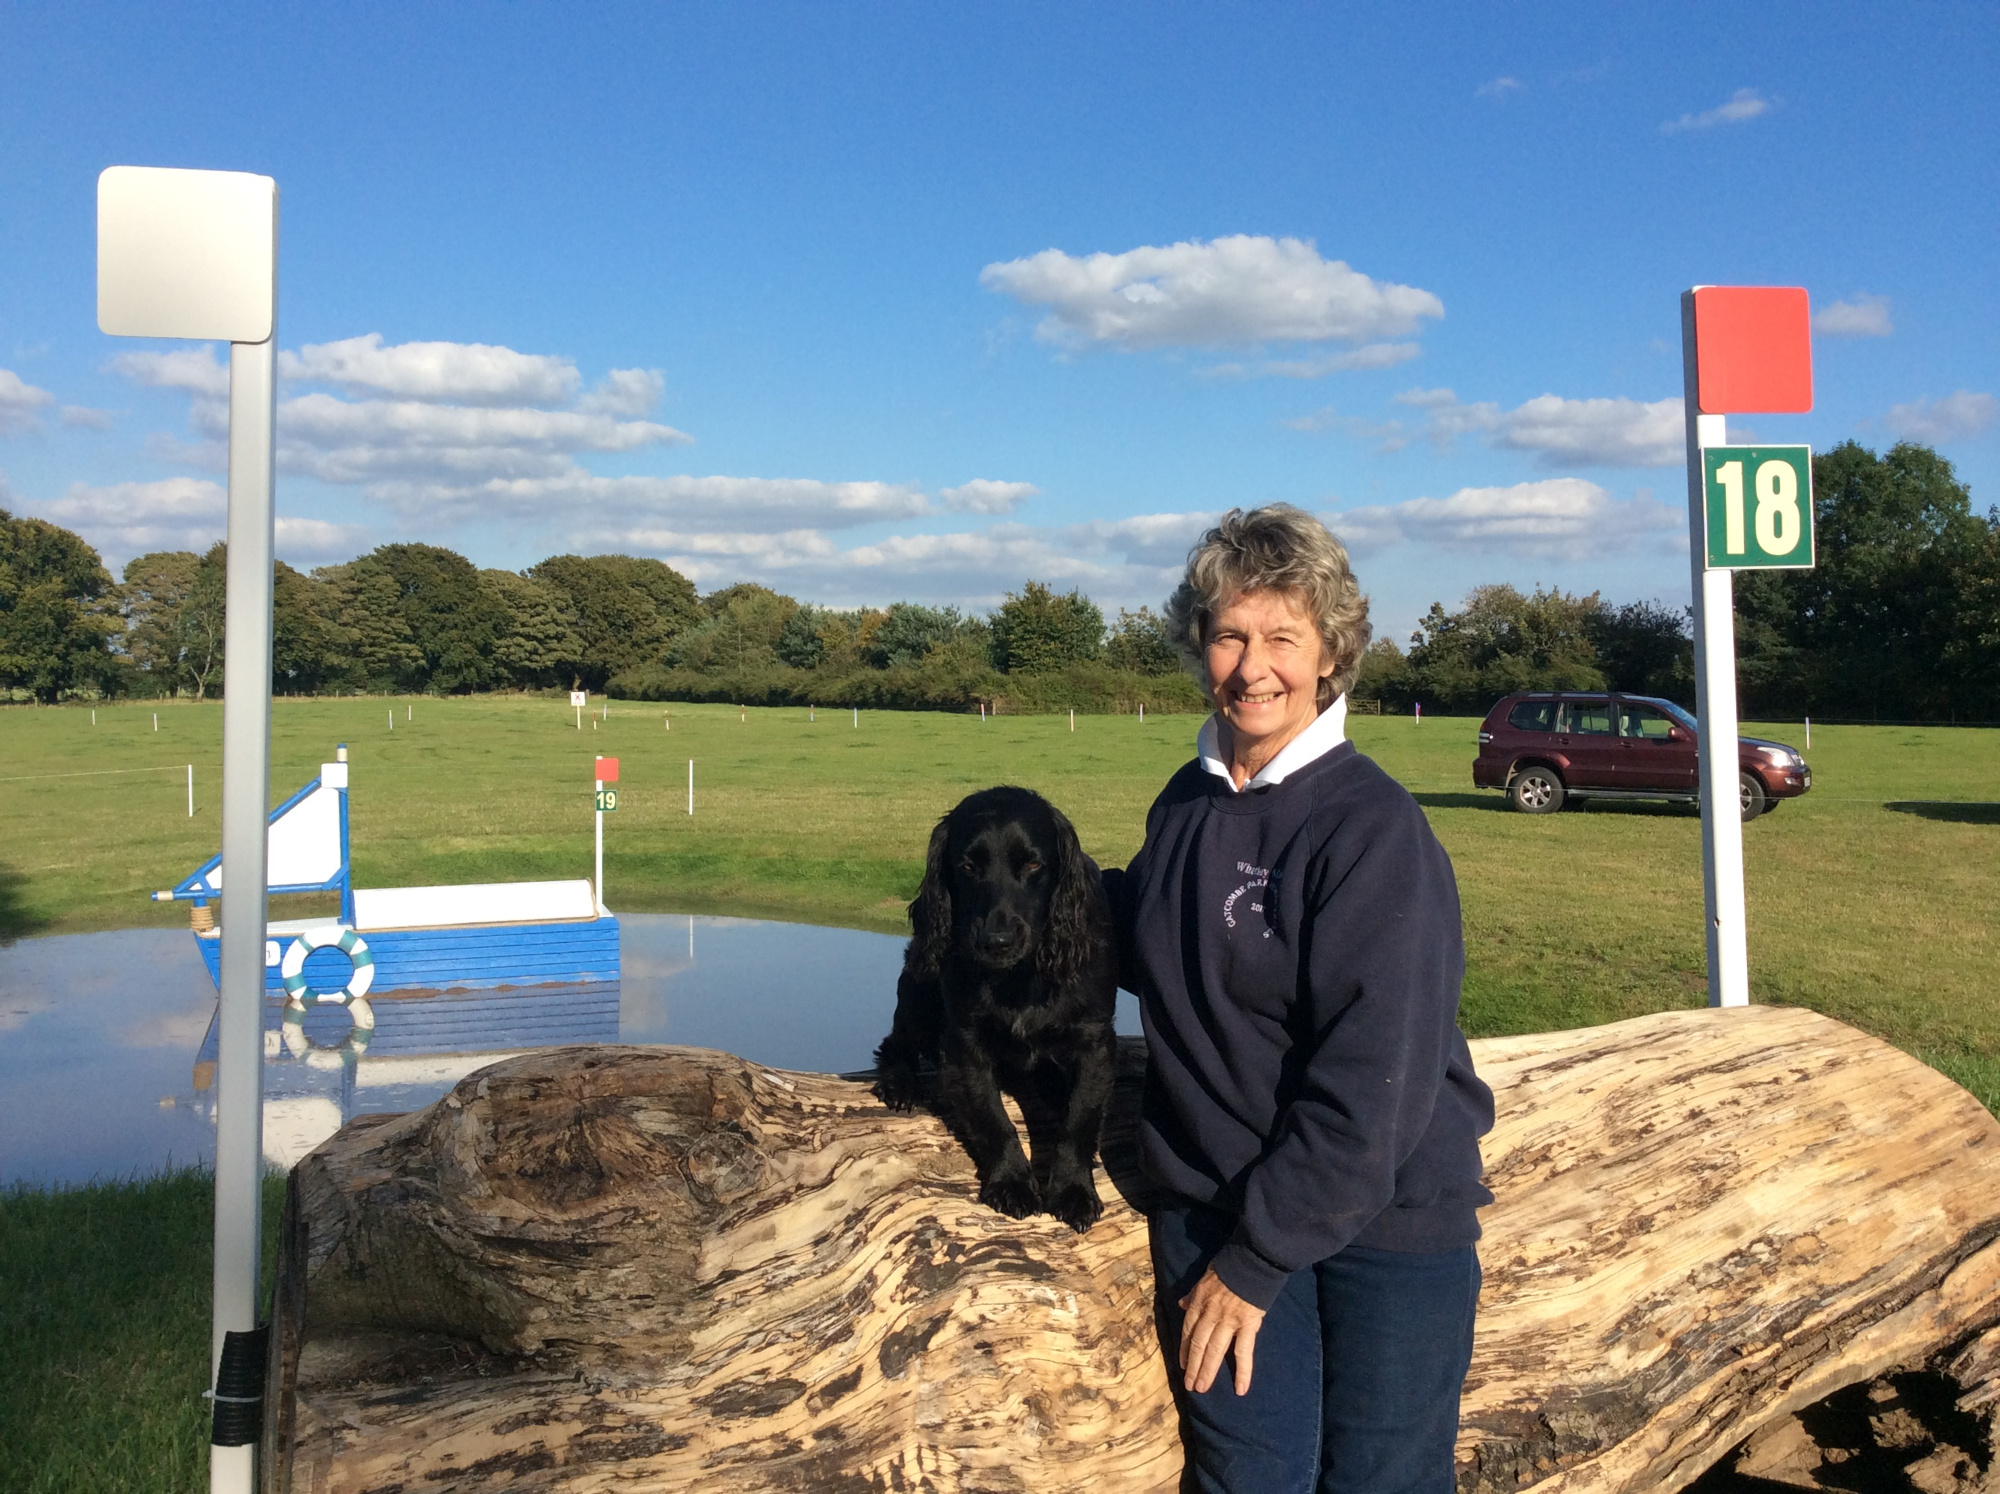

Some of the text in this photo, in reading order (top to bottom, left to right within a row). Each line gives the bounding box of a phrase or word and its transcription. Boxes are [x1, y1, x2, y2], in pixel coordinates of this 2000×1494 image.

[1716, 460, 1800, 556] 18
[597, 792, 616, 810] 19
[1223, 885, 1247, 928] GATCOMBE
